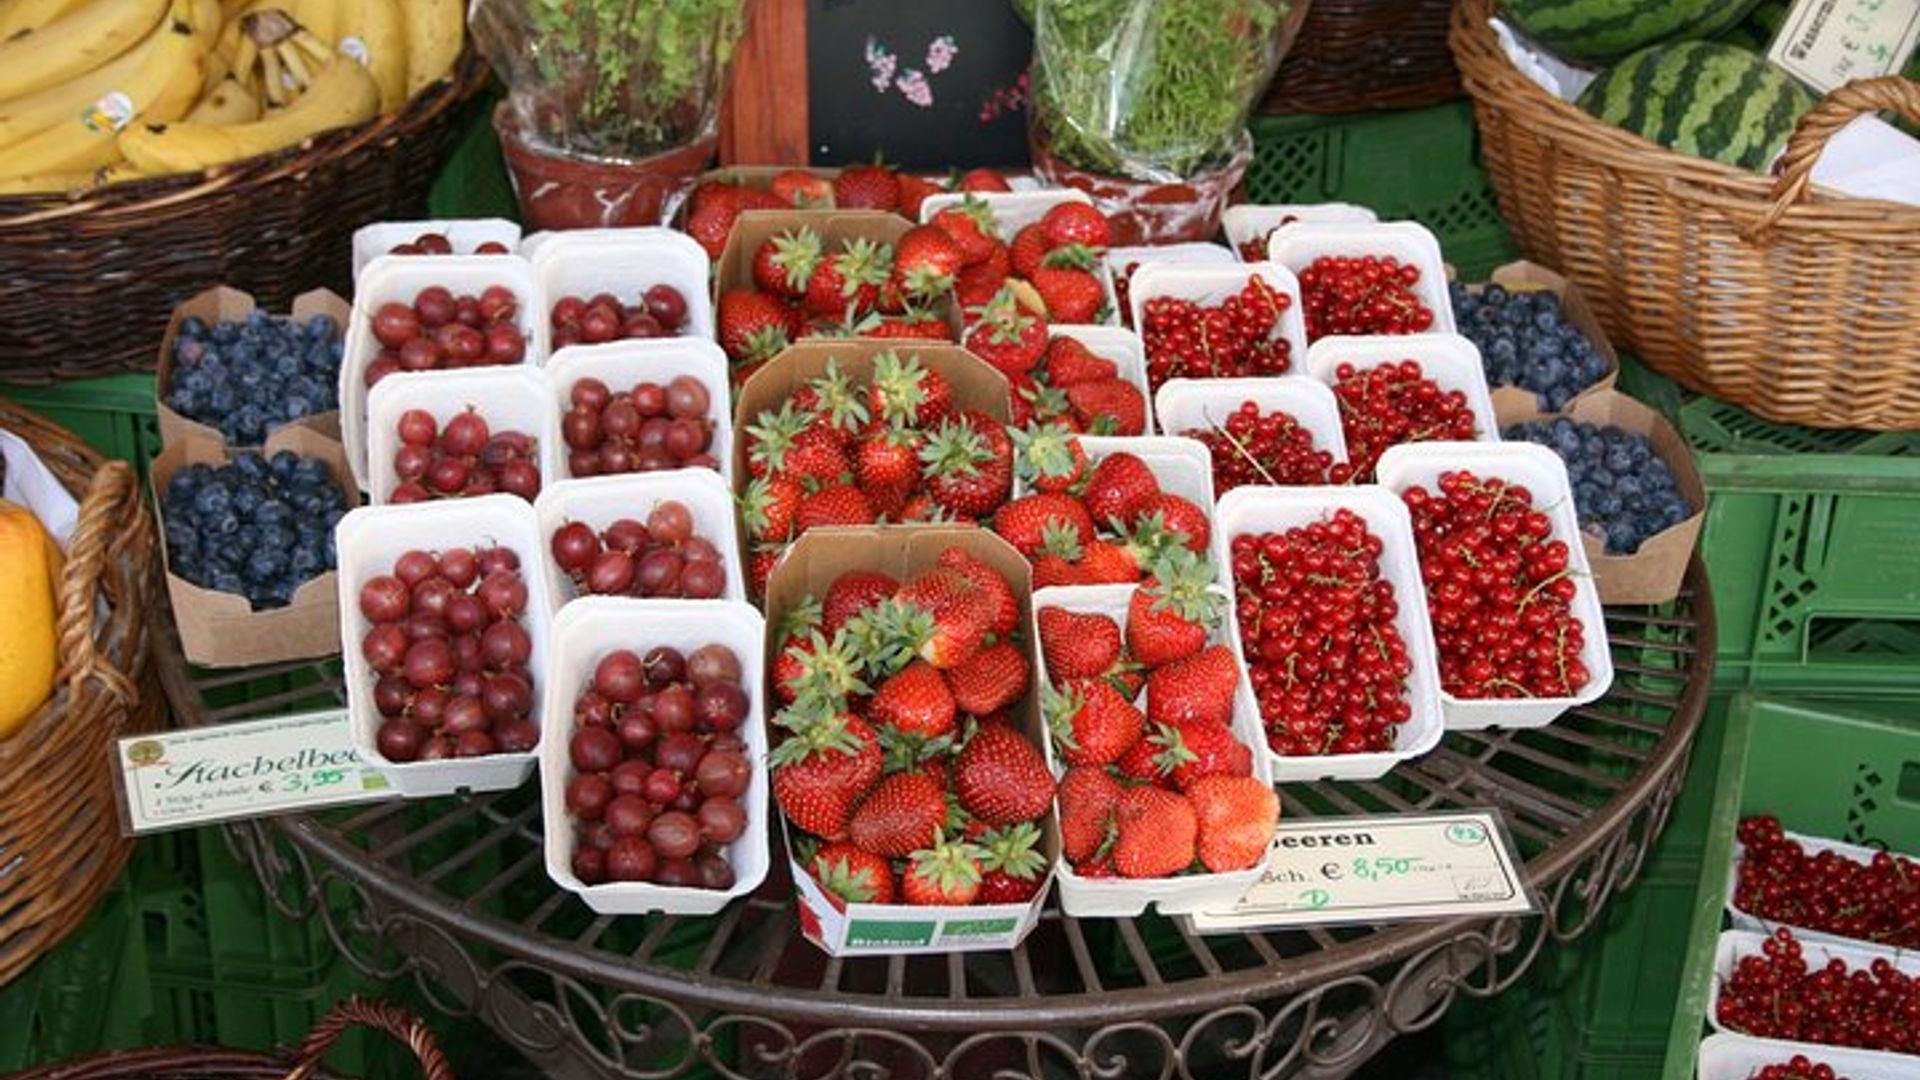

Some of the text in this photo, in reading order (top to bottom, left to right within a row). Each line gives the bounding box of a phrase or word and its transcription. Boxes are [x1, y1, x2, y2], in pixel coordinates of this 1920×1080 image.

[258, 779, 274, 793] €
[282, 768, 344, 794] 3,95
[1273, 832, 1375, 849] eeren
[1320, 862, 1344, 880] €
[1352, 857, 1418, 882] 8,50
